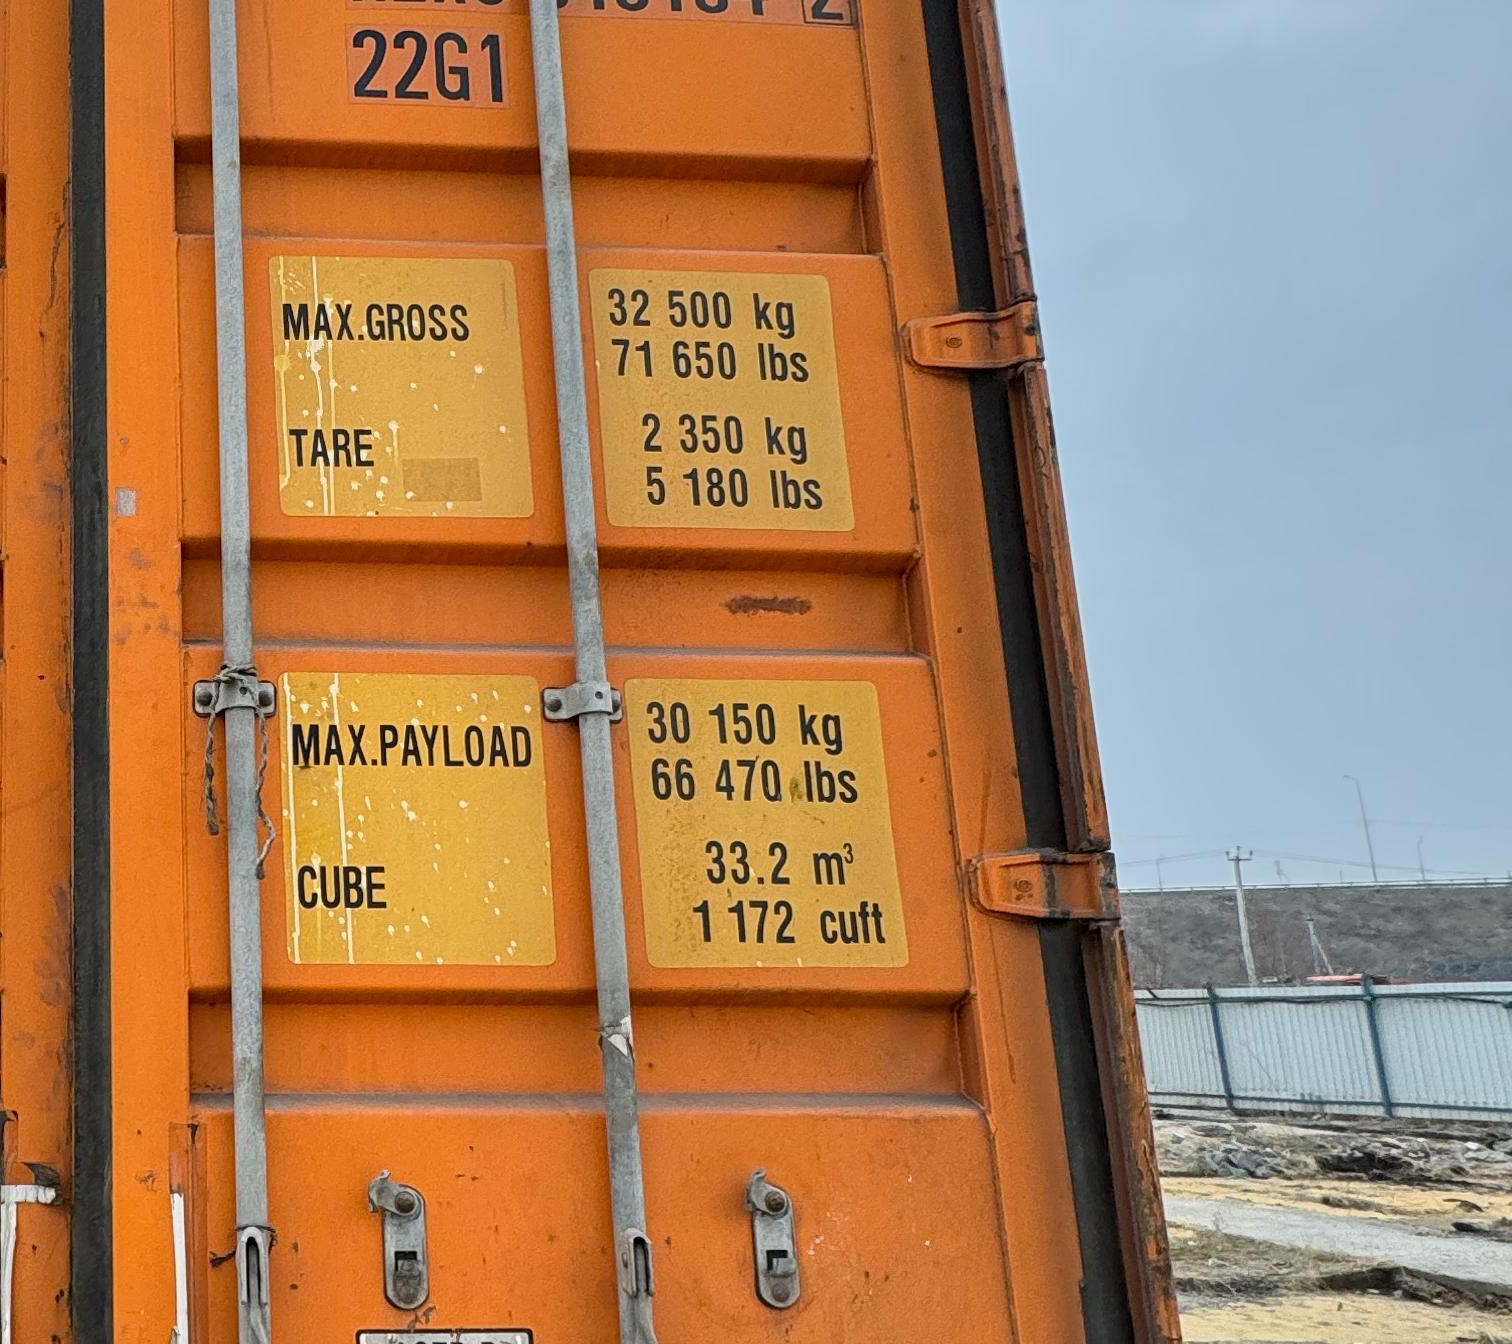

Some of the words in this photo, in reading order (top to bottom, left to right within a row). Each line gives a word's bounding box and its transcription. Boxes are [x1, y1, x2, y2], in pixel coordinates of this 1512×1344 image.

[352, 29, 504, 103] 22G1
[282, 303, 470, 342] MAX.GROSS
[607, 288, 651, 327] 32
[668, 290, 732, 329] 500
[752, 292, 795, 340] kg
[611, 339, 653, 378] 71
[672, 340, 737, 380] 650
[757, 342, 809, 383] lbs
[288, 428, 375, 468] TARE
[642, 413, 662, 453] 2
[678, 413, 744, 455] 350
[764, 416, 808, 465] kg
[646, 466, 666, 506] 5
[682, 467, 748, 508] 180
[769, 469, 823, 510] lbs
[292, 723, 532, 768] MAX.PAYLOAD
[646, 701, 691, 744] 30
[708, 702, 776, 745] 150
[798, 704, 843, 756] kg
[651, 758, 695, 801] 66
[715, 759, 782, 802] 470
[803, 760, 858, 804] lbs
[297, 865, 387, 909] CUBE
[705, 840, 790, 885] 33.2
[727, 900, 796, 944] 172
[820, 900, 886, 945] cuft
